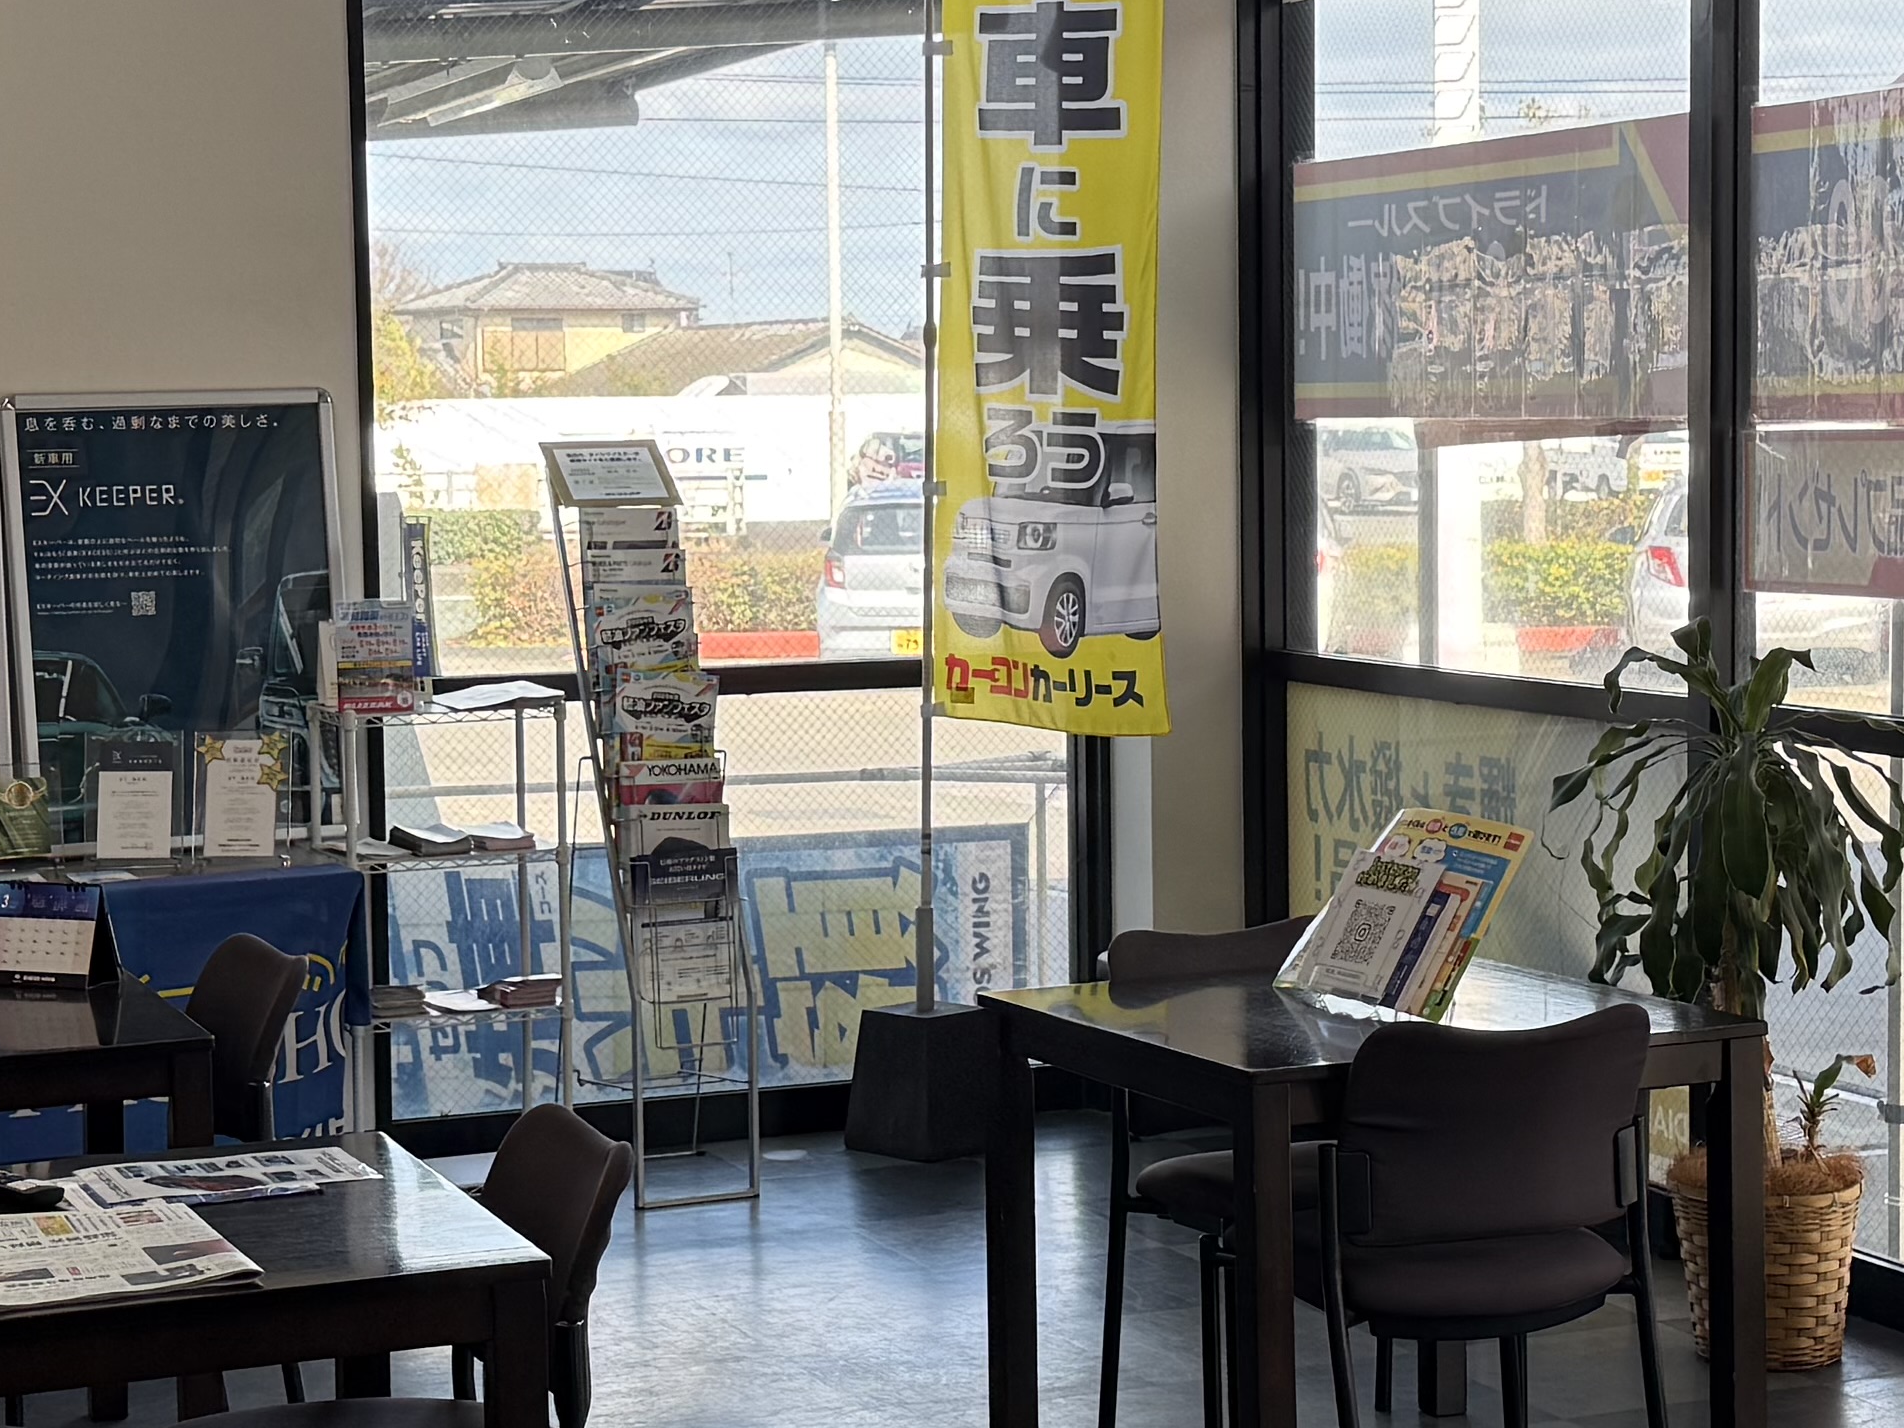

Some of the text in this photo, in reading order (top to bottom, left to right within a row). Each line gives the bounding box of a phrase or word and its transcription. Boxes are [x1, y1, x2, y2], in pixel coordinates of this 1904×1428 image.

[33, 451, 74, 466] 新車用
[77, 484, 177, 509] KEEPER
[646, 761, 719, 778] YOKOHAMA
[972, 871, 992, 948] WING
